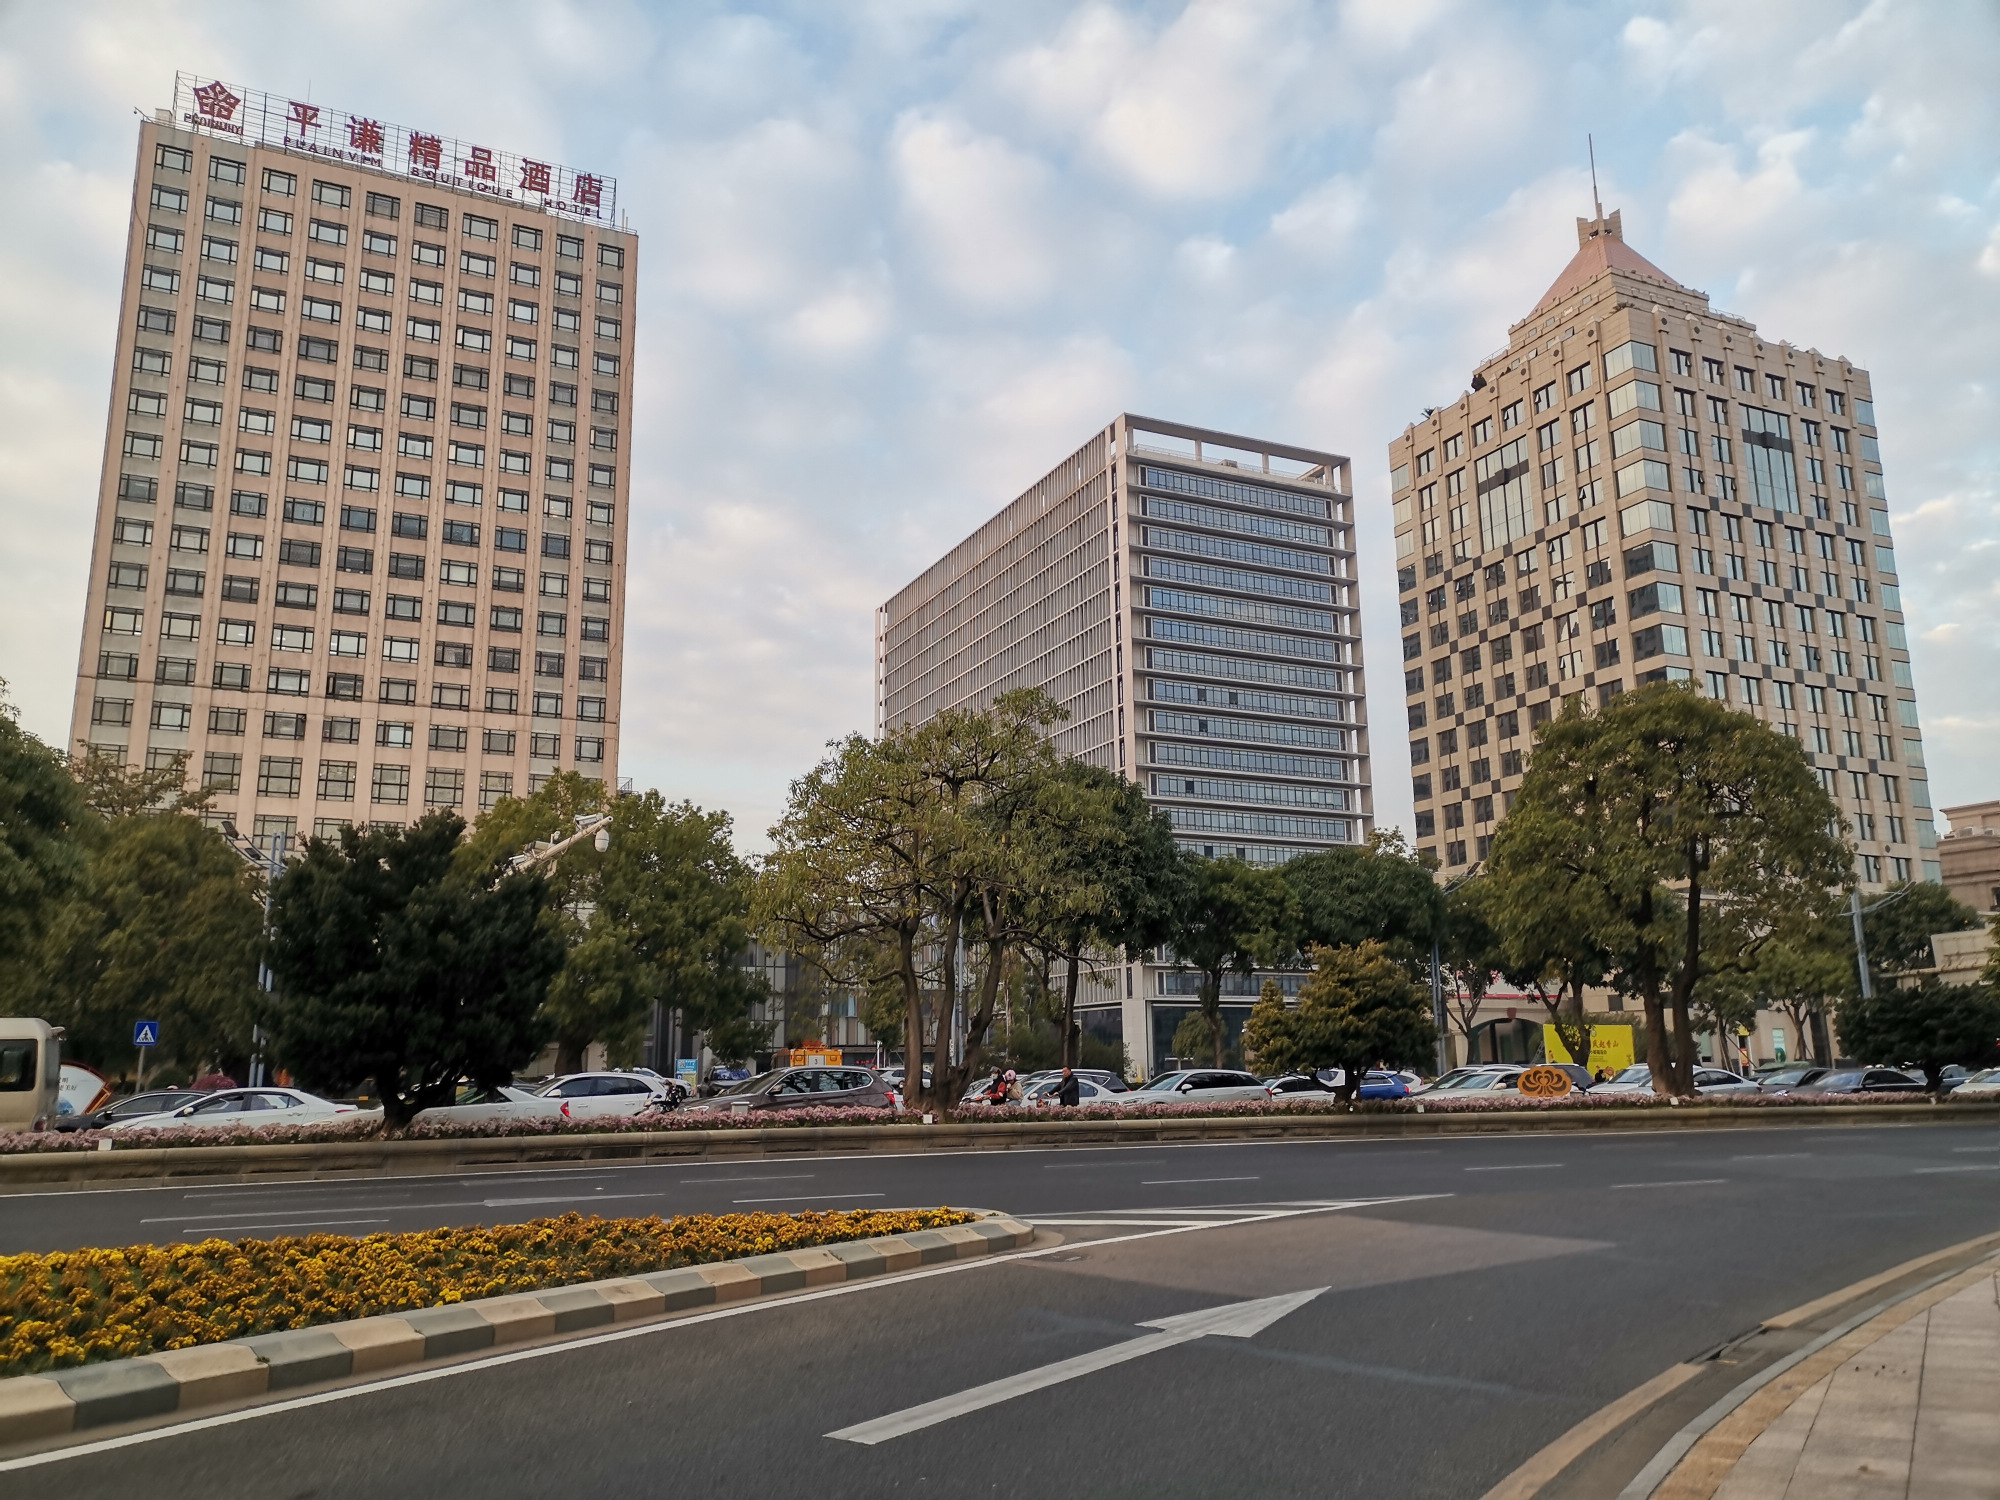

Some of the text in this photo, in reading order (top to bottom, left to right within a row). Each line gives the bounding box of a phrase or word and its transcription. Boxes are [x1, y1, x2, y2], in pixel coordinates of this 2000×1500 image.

[286, 101, 602, 206] 平谦精品酒店
[410, 166, 513, 199] BOUTIQUE
[544, 197, 602, 219] HOTEL
